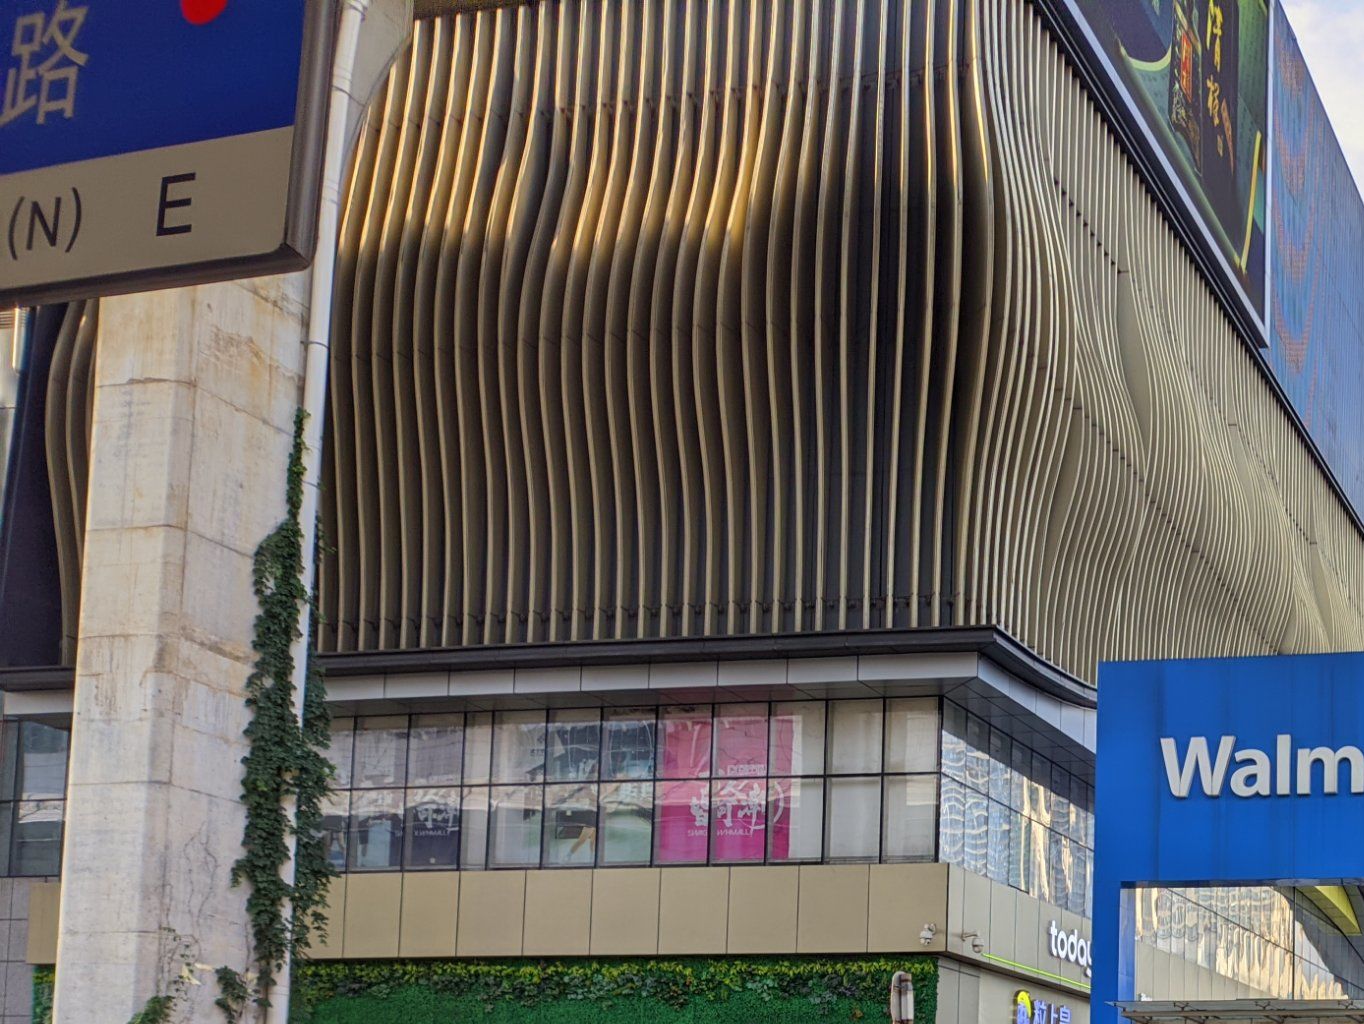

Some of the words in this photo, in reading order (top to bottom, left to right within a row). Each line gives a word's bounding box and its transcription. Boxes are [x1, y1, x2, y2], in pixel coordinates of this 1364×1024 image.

[0, 0, 89, 126] 路
[7, 187, 83, 261] (N)
[155, 172, 197, 237] E
